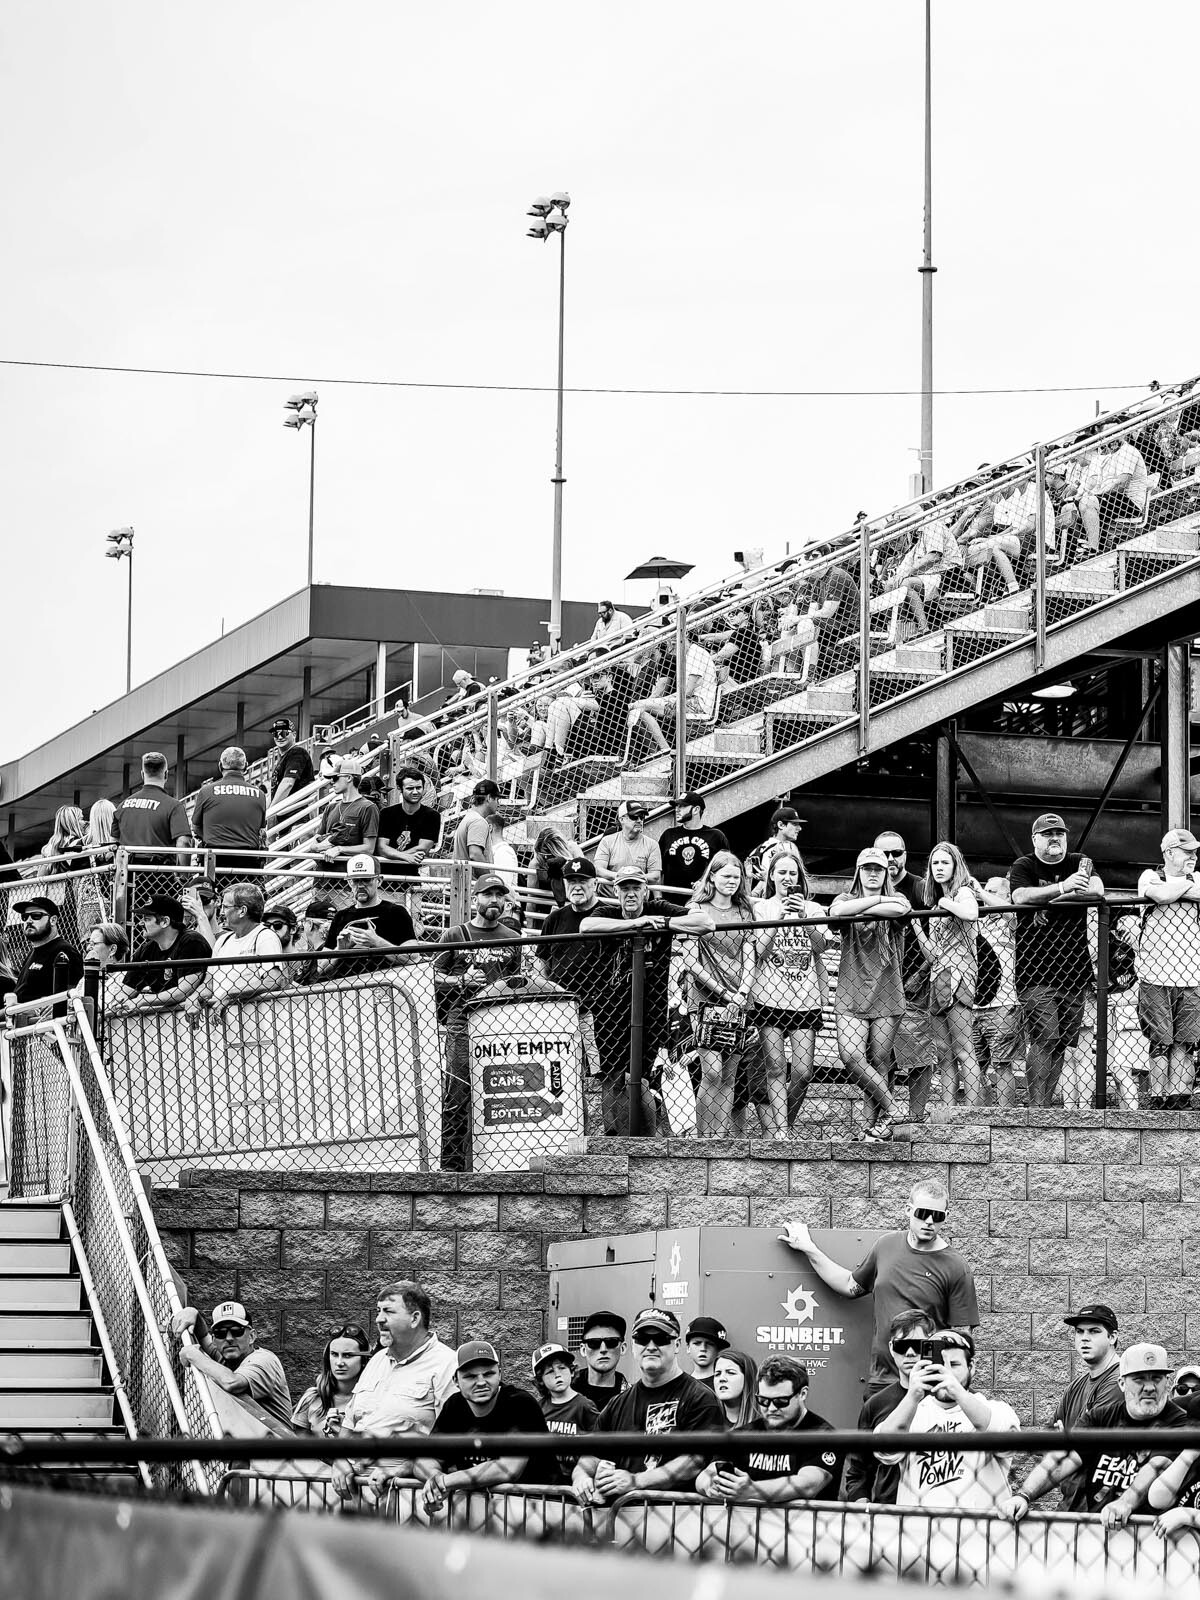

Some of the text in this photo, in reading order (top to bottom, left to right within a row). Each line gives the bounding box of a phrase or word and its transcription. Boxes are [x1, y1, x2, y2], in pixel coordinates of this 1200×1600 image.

[213, 785, 261, 798] SECURITY
[122, 797, 161, 811] SECURITY
[691, 836, 710, 860] CREW
[474, 1041, 571, 1059] ONLY EMPTY
[490, 1075, 525, 1087] CANS
[552, 1063, 561, 1089] AND
[490, 1107, 542, 1119] BOTTLES
[768, 1343, 831, 1351] RENTALS
[806, 1360, 828, 1368] HVAC
[545, 1420, 577, 1435] AMAHA
[918, 1455, 964, 1489] DOWN
